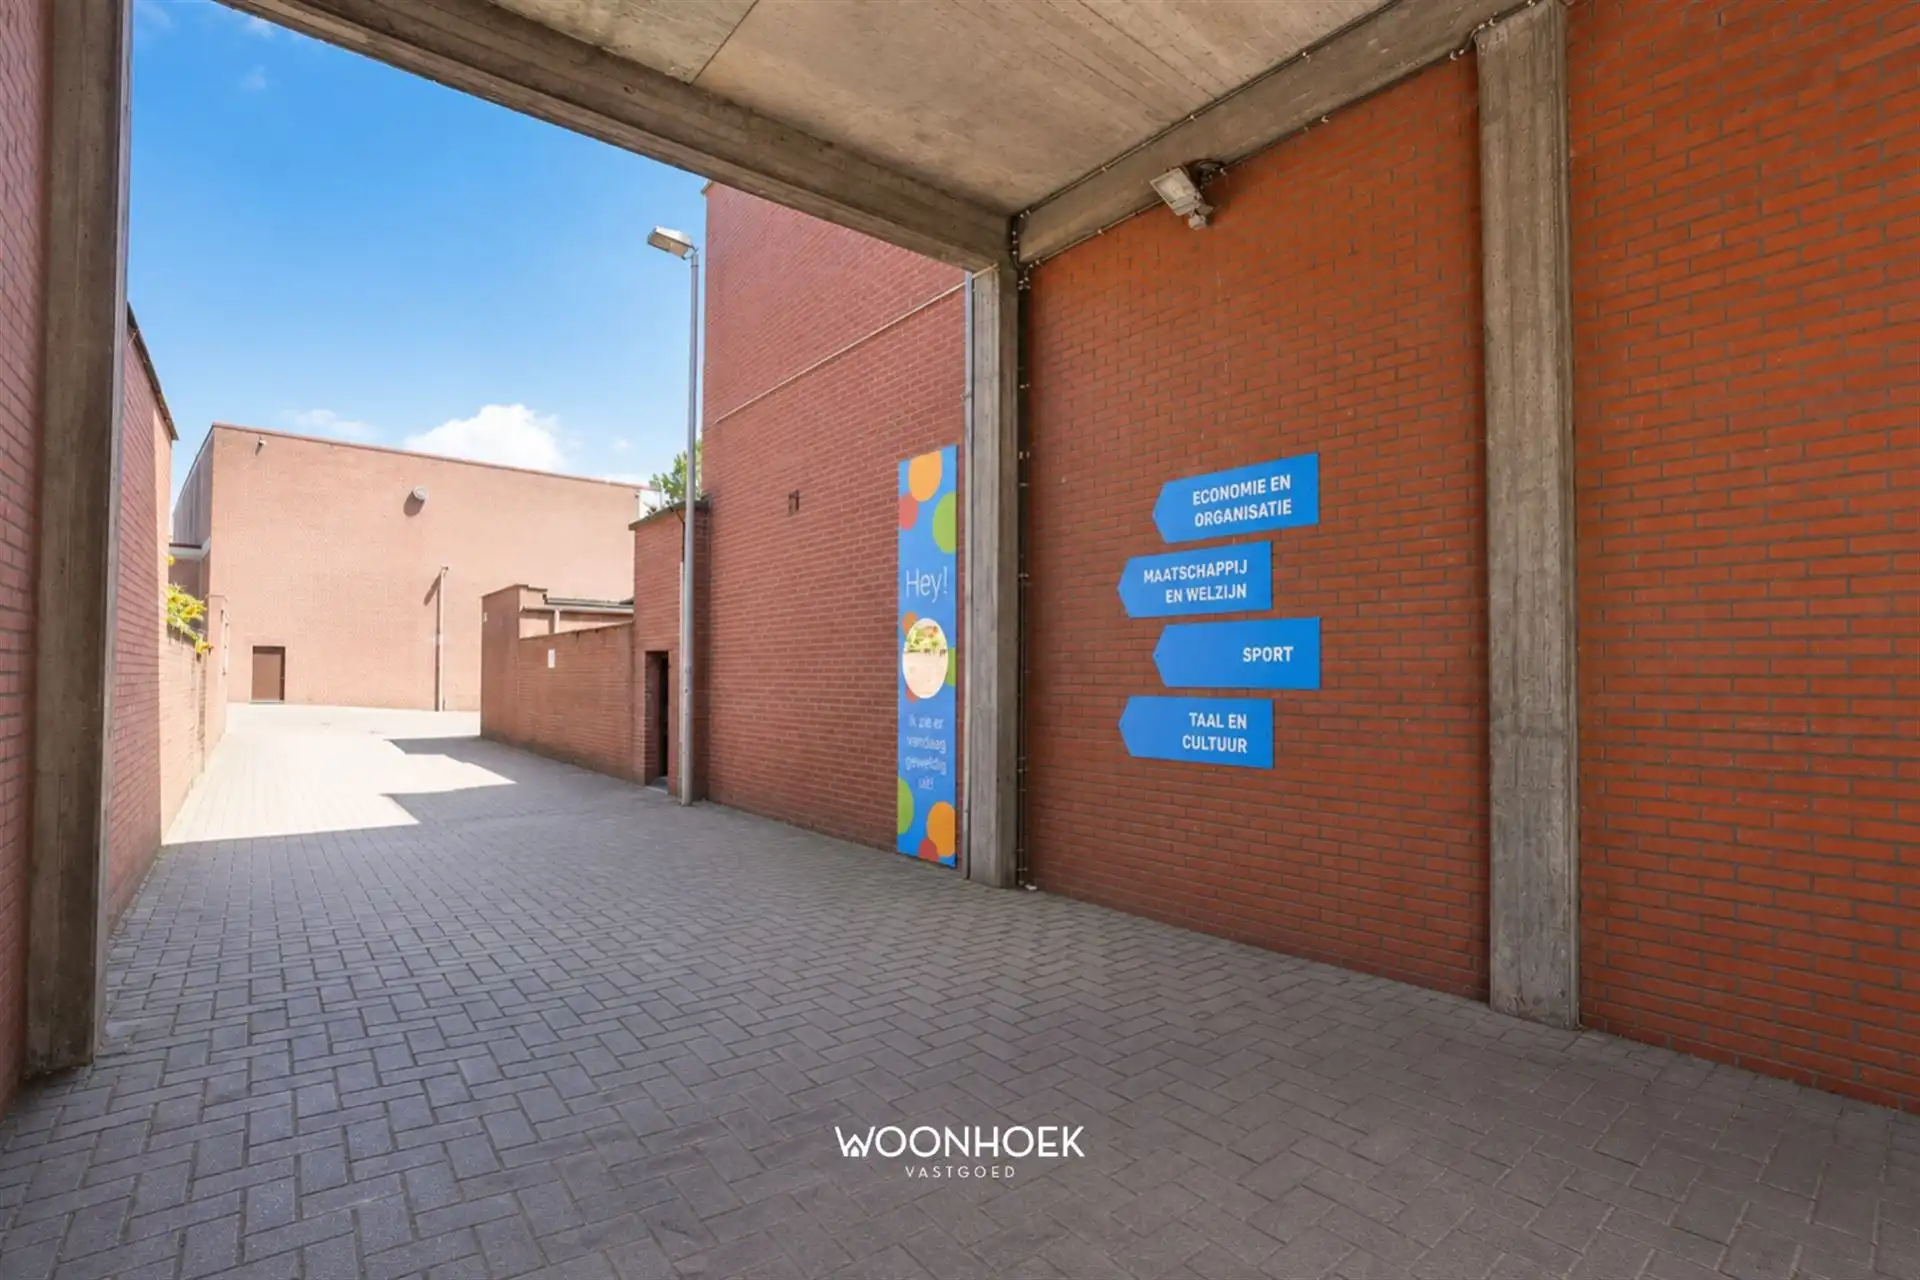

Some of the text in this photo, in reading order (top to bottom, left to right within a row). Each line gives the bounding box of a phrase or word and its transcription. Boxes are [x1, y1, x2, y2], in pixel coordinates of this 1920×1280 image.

[1192, 474, 1291, 505] ECONOMIE EN
[1194, 499, 1292, 527] ORGANISATIE
[1143, 559, 1248, 583] MAATSCHAPPIJ
[906, 565, 948, 603] Hey!
[1165, 583, 1247, 604] EN WELZIJN
[1242, 646, 1294, 663] SPORT
[1188, 712, 1248, 730] TAAL EN
[1182, 734, 1248, 753] CULTUUR
